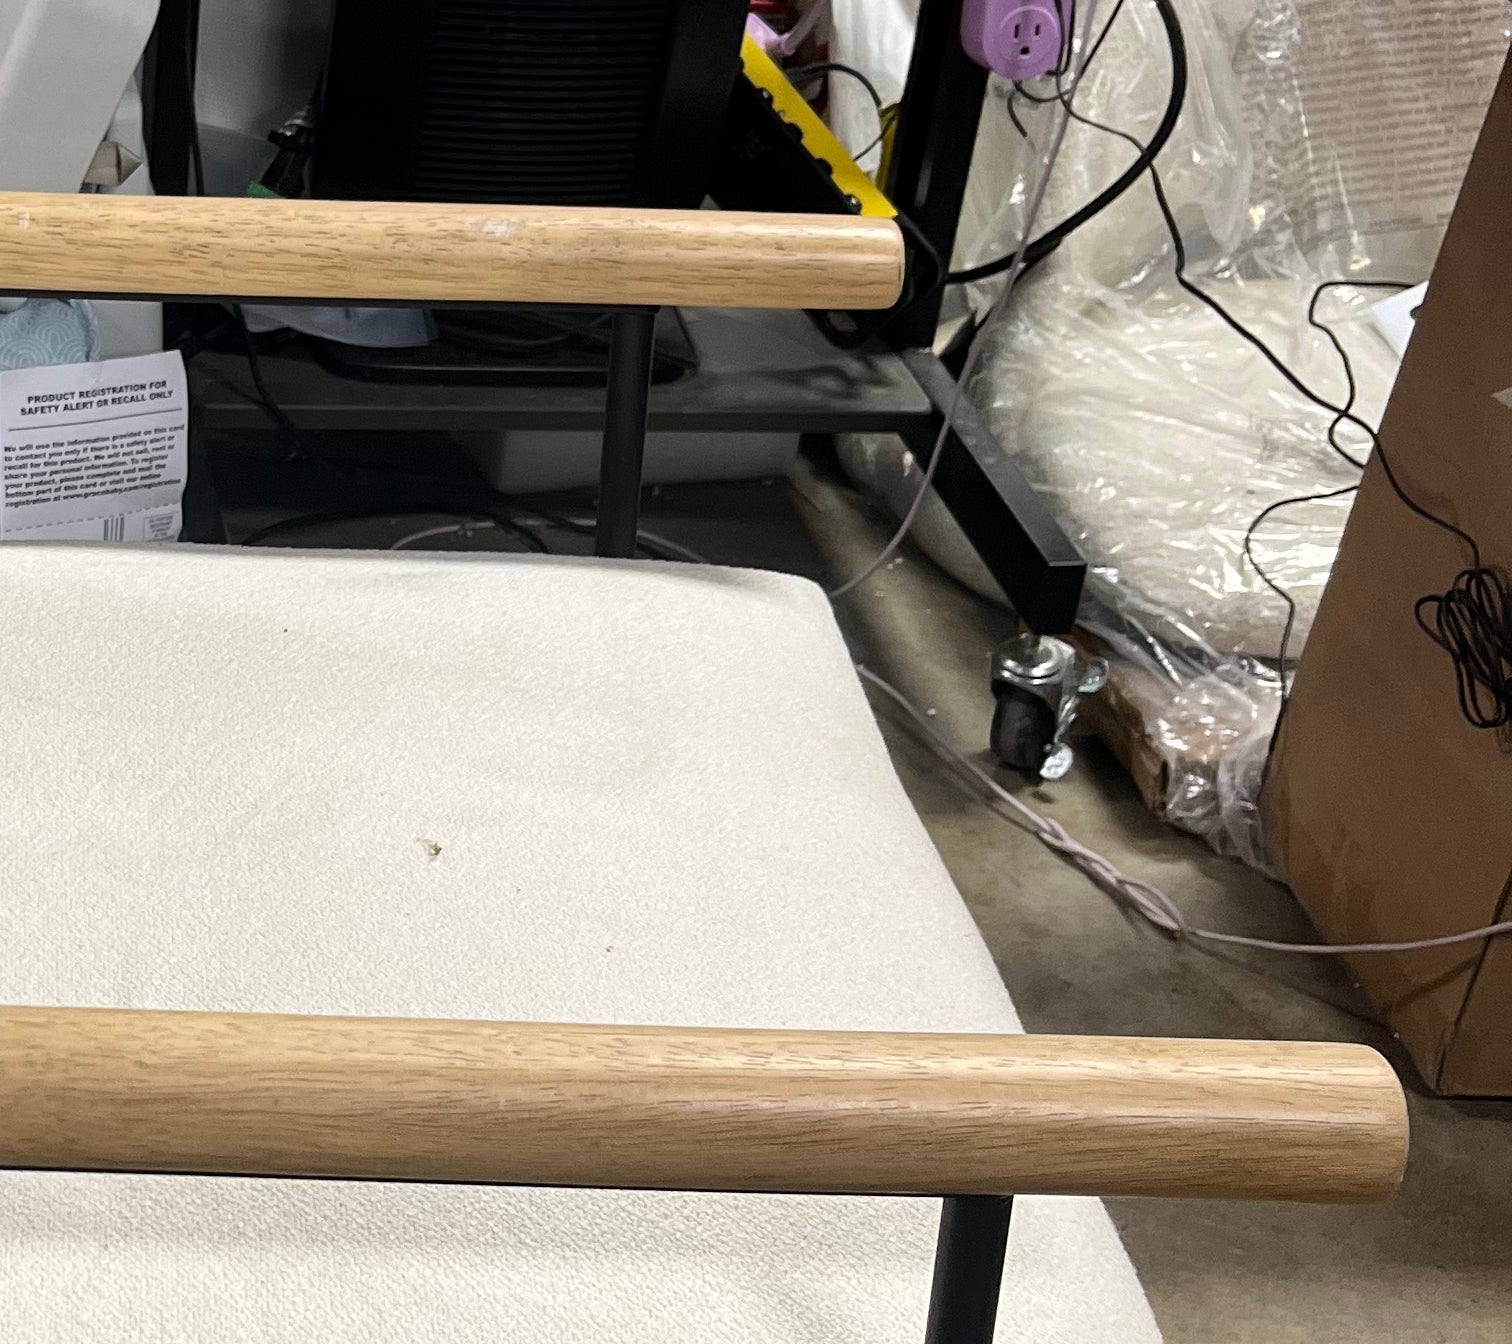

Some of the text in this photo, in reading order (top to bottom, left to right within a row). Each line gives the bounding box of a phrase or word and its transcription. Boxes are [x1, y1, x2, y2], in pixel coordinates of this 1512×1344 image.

[20, 406, 60, 416] SAFETY
[63, 401, 93, 412] ALERT
[111, 395, 147, 405] RECALL
[150, 390, 174, 401] ONLY
[27, 380, 167, 404] PRODUCT REGISTRATION FOR
[15, 452, 47, 461] contact
[49, 451, 62, 460] you
[64, 449, 81, 458] only
[90, 445, 109, 453] there
[126, 440, 147, 449] safety
[149, 437, 166, 445] alert
[67, 436, 114, 447] information
[112, 432, 142, 442] provided
[169, 425, 185, 433] card
[4, 462, 28, 471] recall
[30, 461, 42, 469] for
[43, 459, 59, 467] this
[107, 452, 120, 460] will
[152, 445, 166, 453] rent
[4, 471, 27, 480] share
[30, 470, 47, 480] your
[49, 466, 83, 477] personal
[141, 454, 168, 464] register
[5, 482, 23, 491] your
[60, 474, 84, 484] please
[86, 470, 121, 481] complete
[138, 465, 153, 473] mail
[5, 490, 34, 499] bottom
[36, 488, 52, 497] part
[64, 484, 78, 492] this
[80, 482, 97, 490] card
[109, 478, 125, 486] visit
[139, 472, 161, 481] online
[5, 496, 51, 508] registration
